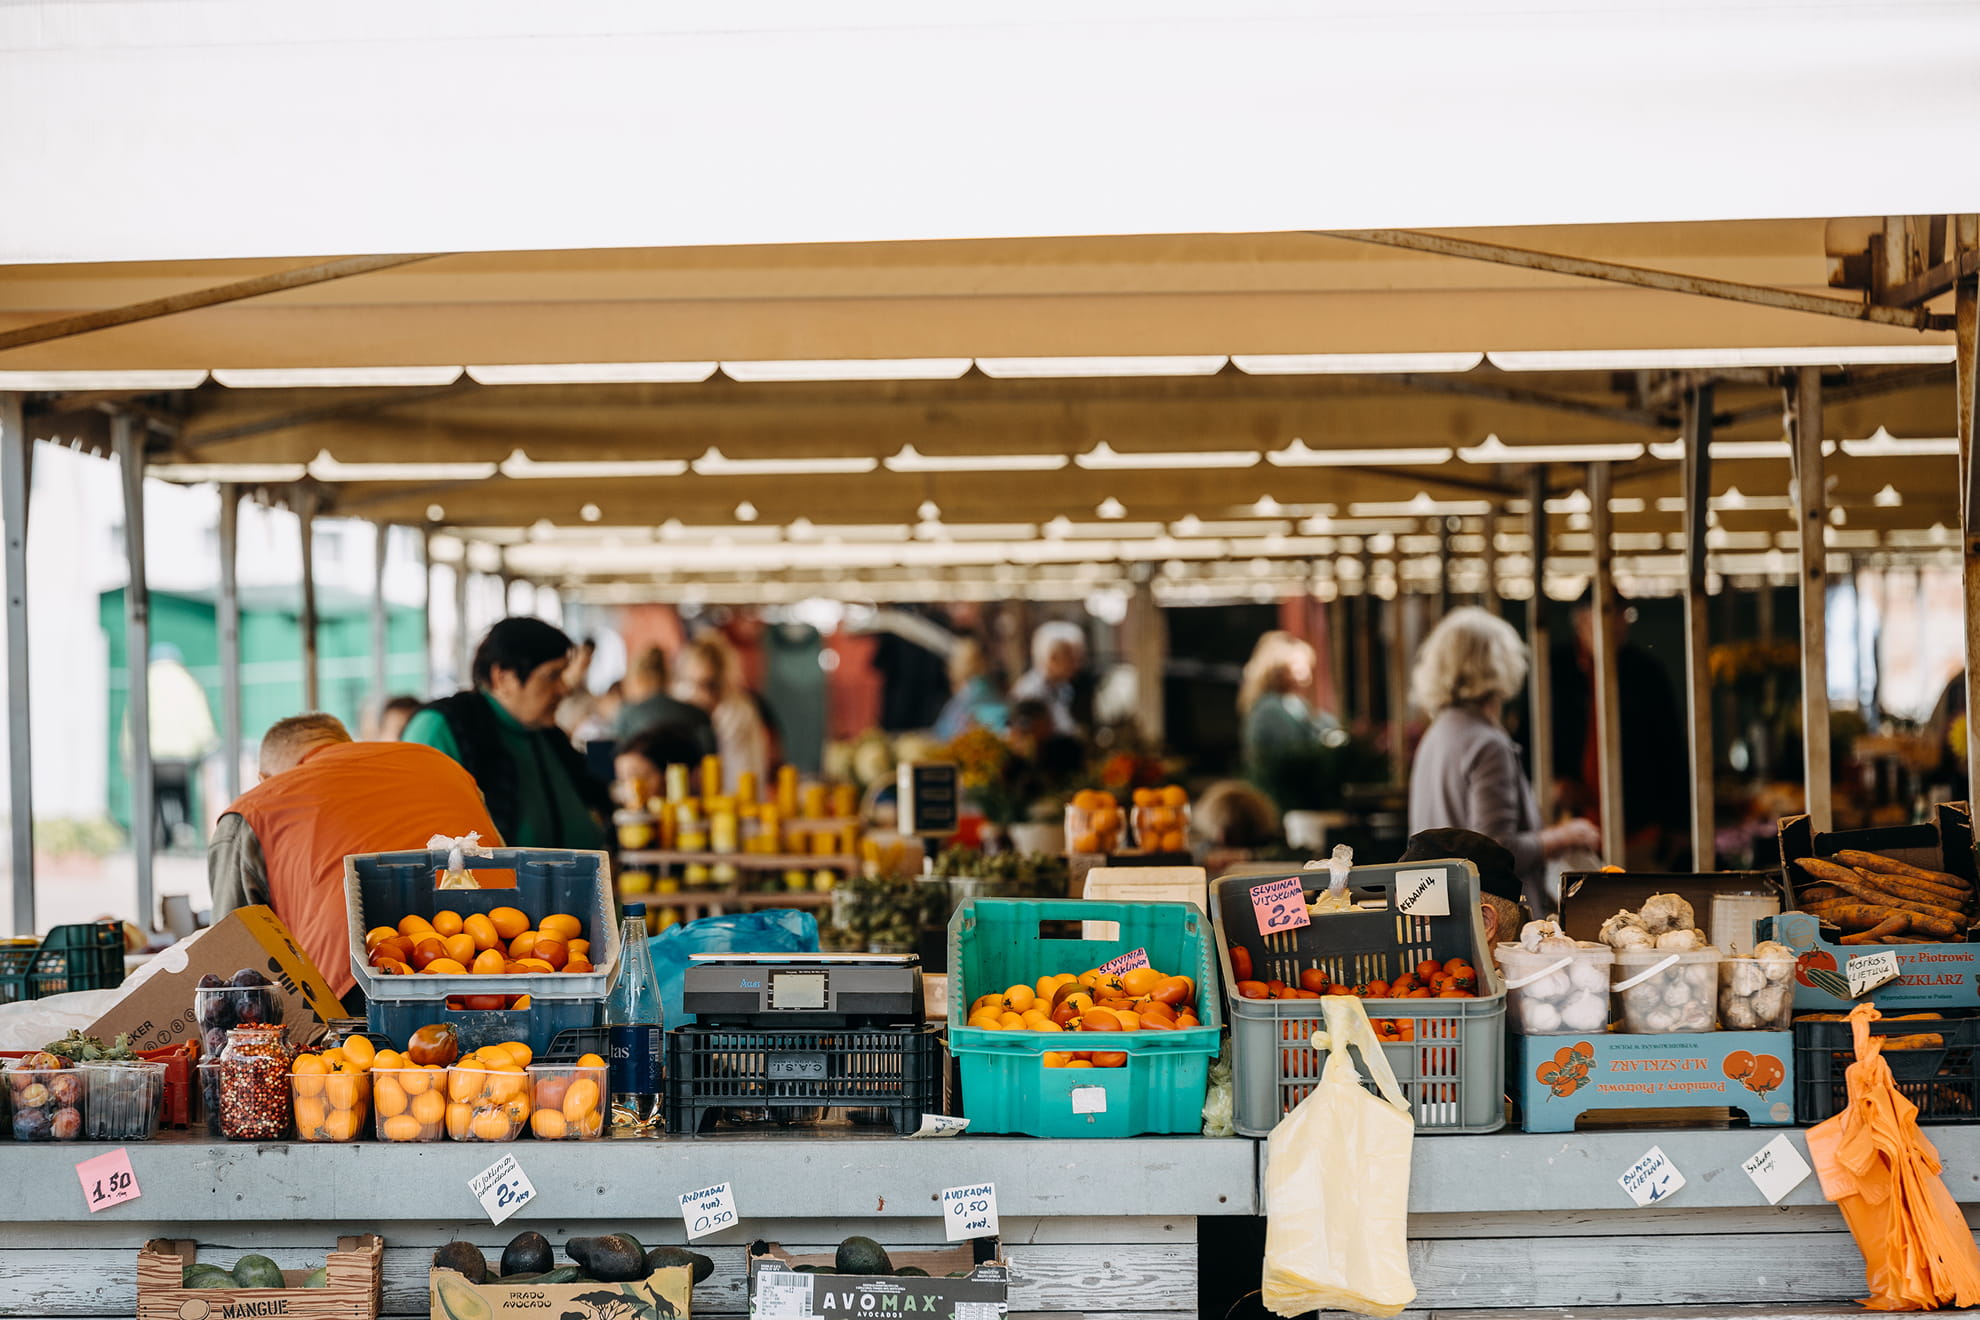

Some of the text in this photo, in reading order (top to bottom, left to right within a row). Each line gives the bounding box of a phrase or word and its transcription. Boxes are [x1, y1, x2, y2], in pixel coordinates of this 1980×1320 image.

[1918, 952, 1975, 963] Piotrowic
[1890, 974, 1964, 986] .SZKLARZ
[773, 1063, 823, 1072] C.A.S.I.
[1597, 1083, 1656, 1094] Piotrowic
[1667, 1080, 1726, 1093] Pomidory
[944, 1186, 992, 1200] AVOKADAI
[954, 1200, 988, 1217] 0,50
[694, 1211, 733, 1231] 0,50
[222, 1300, 289, 1319] MANGUE
